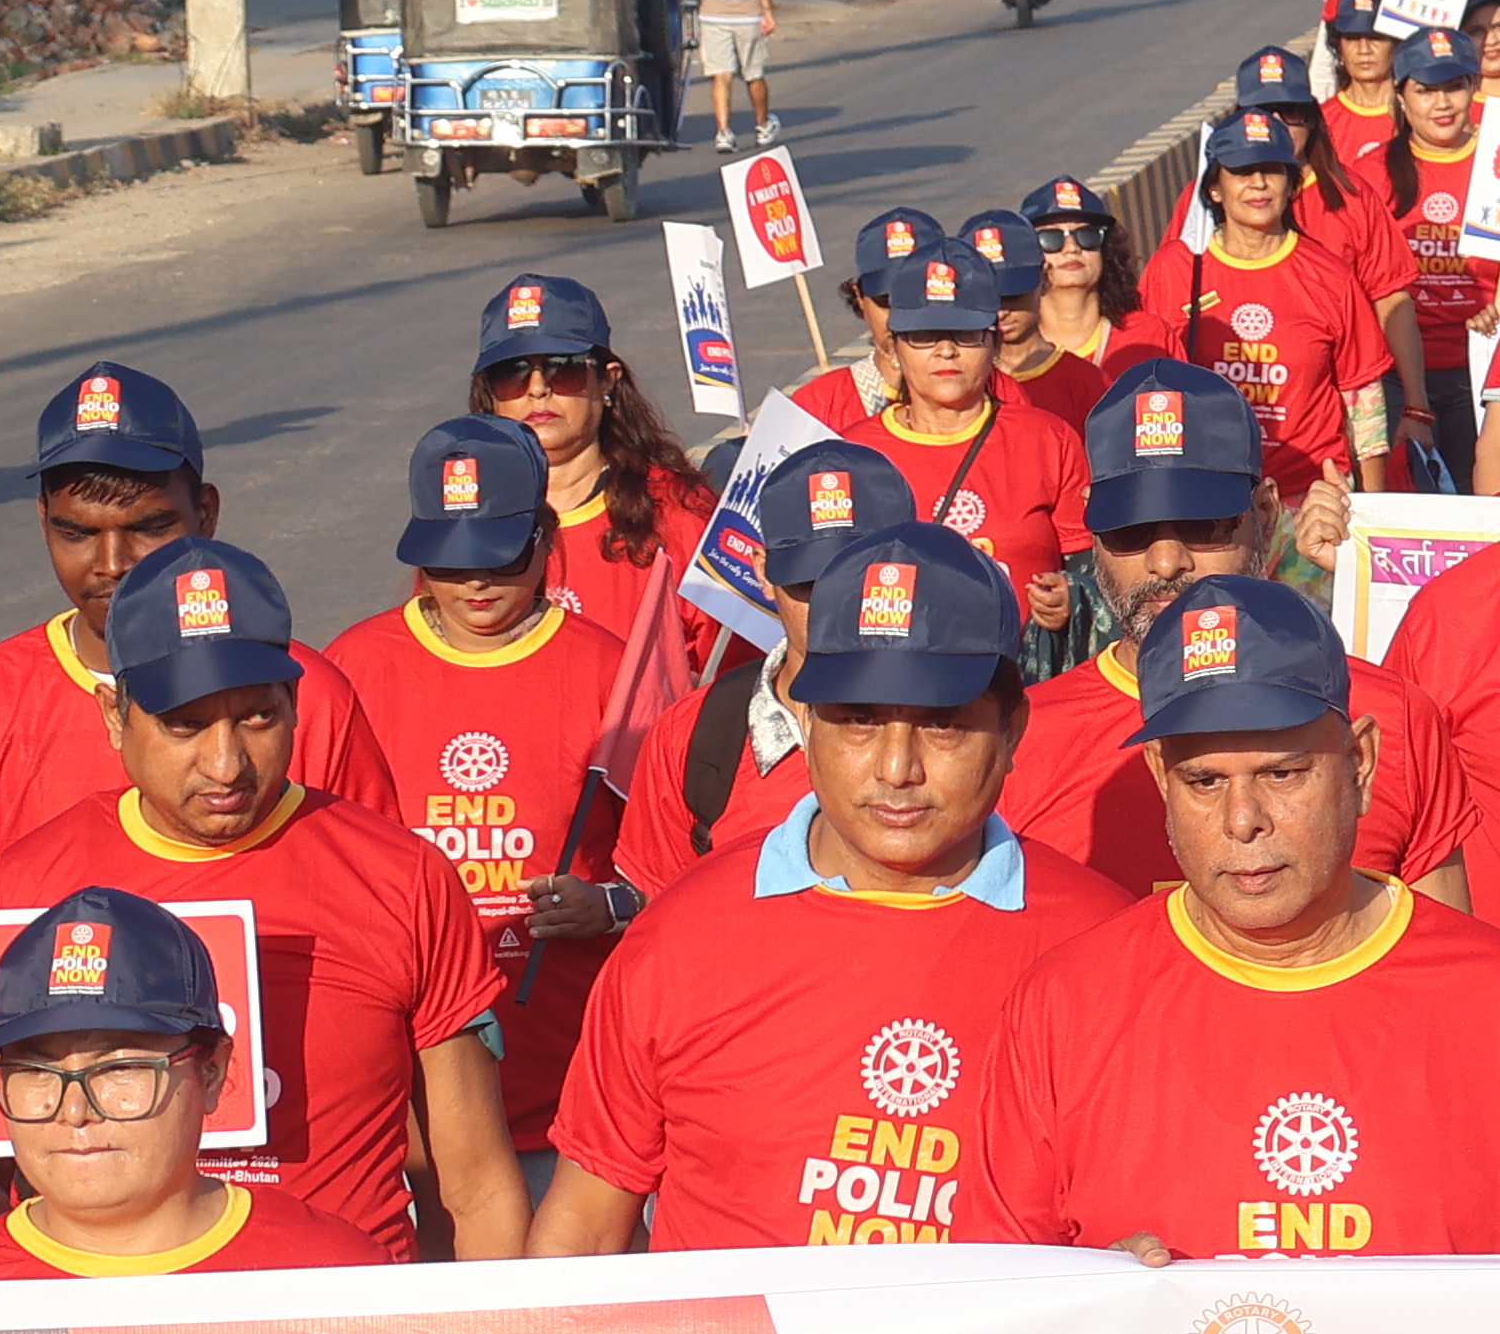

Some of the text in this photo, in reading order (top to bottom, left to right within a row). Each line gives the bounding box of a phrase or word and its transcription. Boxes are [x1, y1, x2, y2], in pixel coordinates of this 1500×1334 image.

[749, 181, 791, 206] I WANT TO
[765, 215, 796, 241] POLIO
